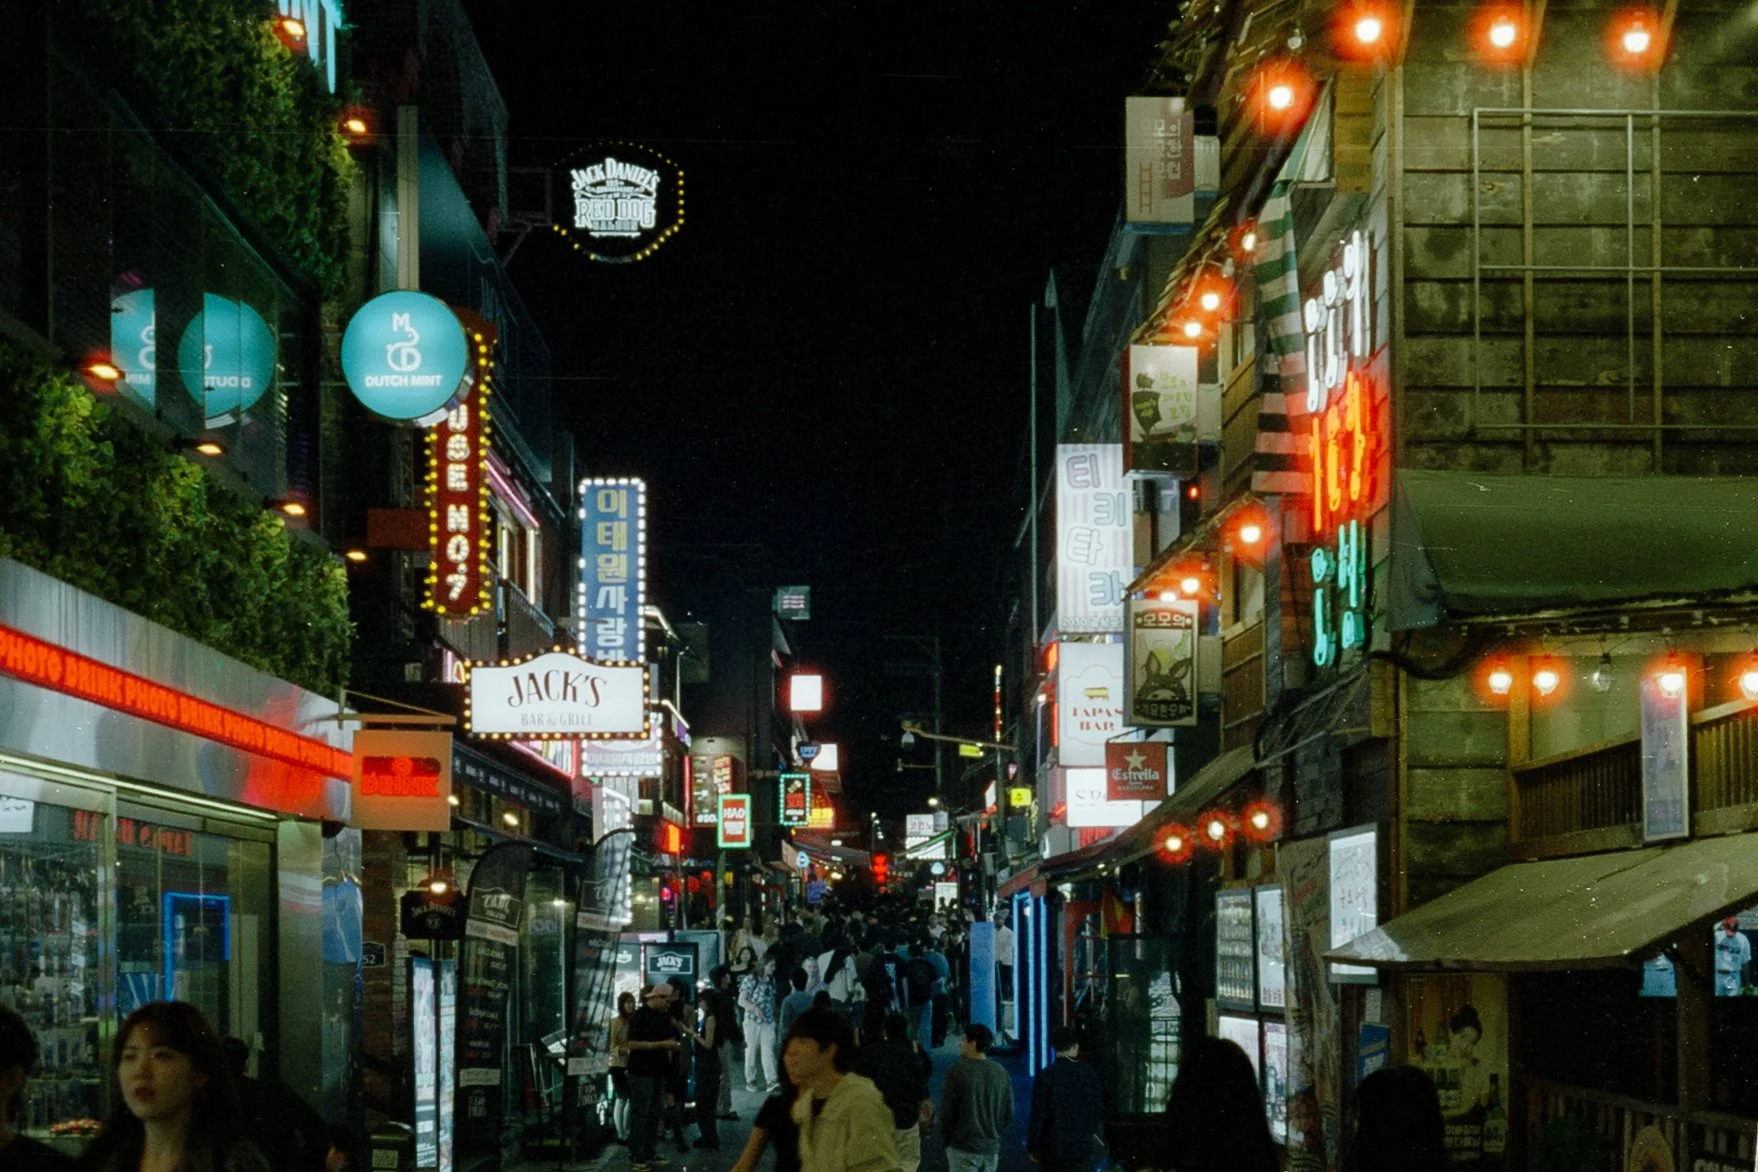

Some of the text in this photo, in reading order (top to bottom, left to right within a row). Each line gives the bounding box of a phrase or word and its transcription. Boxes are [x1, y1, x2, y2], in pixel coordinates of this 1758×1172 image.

[570, 163, 606, 191] JACK
[364, 374, 442, 387] DUTCH MINT
[507, 669, 608, 709] JACK'S
[520, 712, 544, 727] BAR
[559, 712, 593, 727] GRILL
[1111, 767, 1161, 783] Estrella
